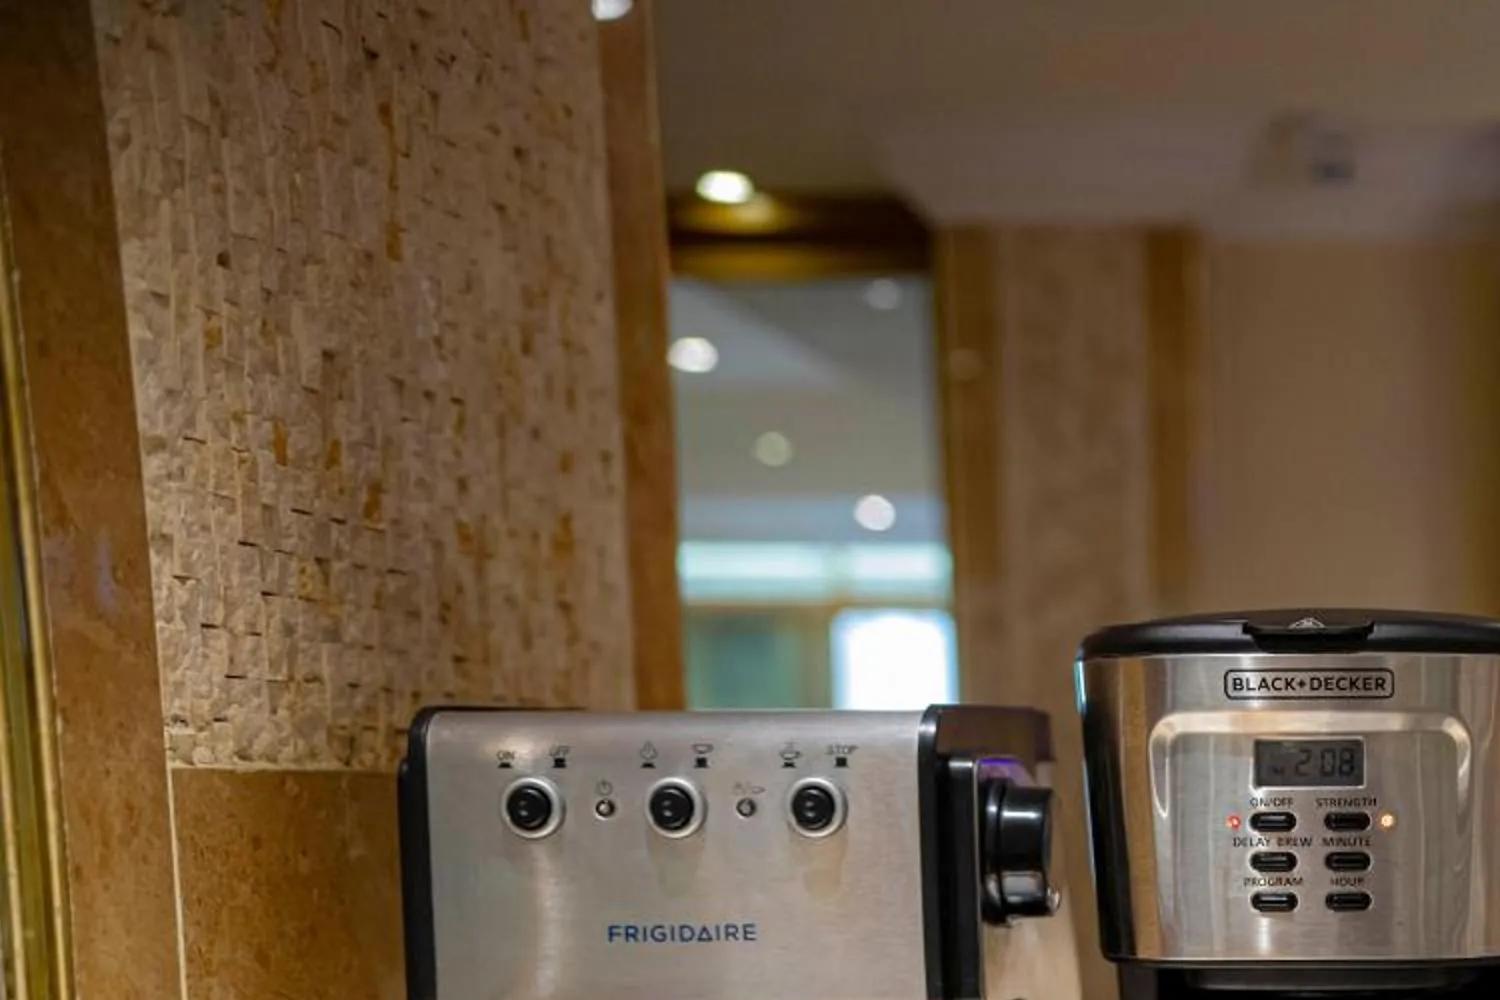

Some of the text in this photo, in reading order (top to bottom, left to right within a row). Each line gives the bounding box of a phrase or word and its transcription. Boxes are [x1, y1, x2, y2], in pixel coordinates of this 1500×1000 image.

[1231, 676, 1387, 692] BLACK+DECKER
[1249, 797, 1295, 808] ON/OFF
[1315, 797, 1378, 808] STRENGTH
[1232, 837, 1313, 848] DELAY BREW
[1321, 837, 1372, 847] MINUTE
[1243, 876, 1304, 887] PROGRAM
[1330, 877, 1364, 887] HOUR
[607, 923, 758, 943] FRIGIDAIRE
